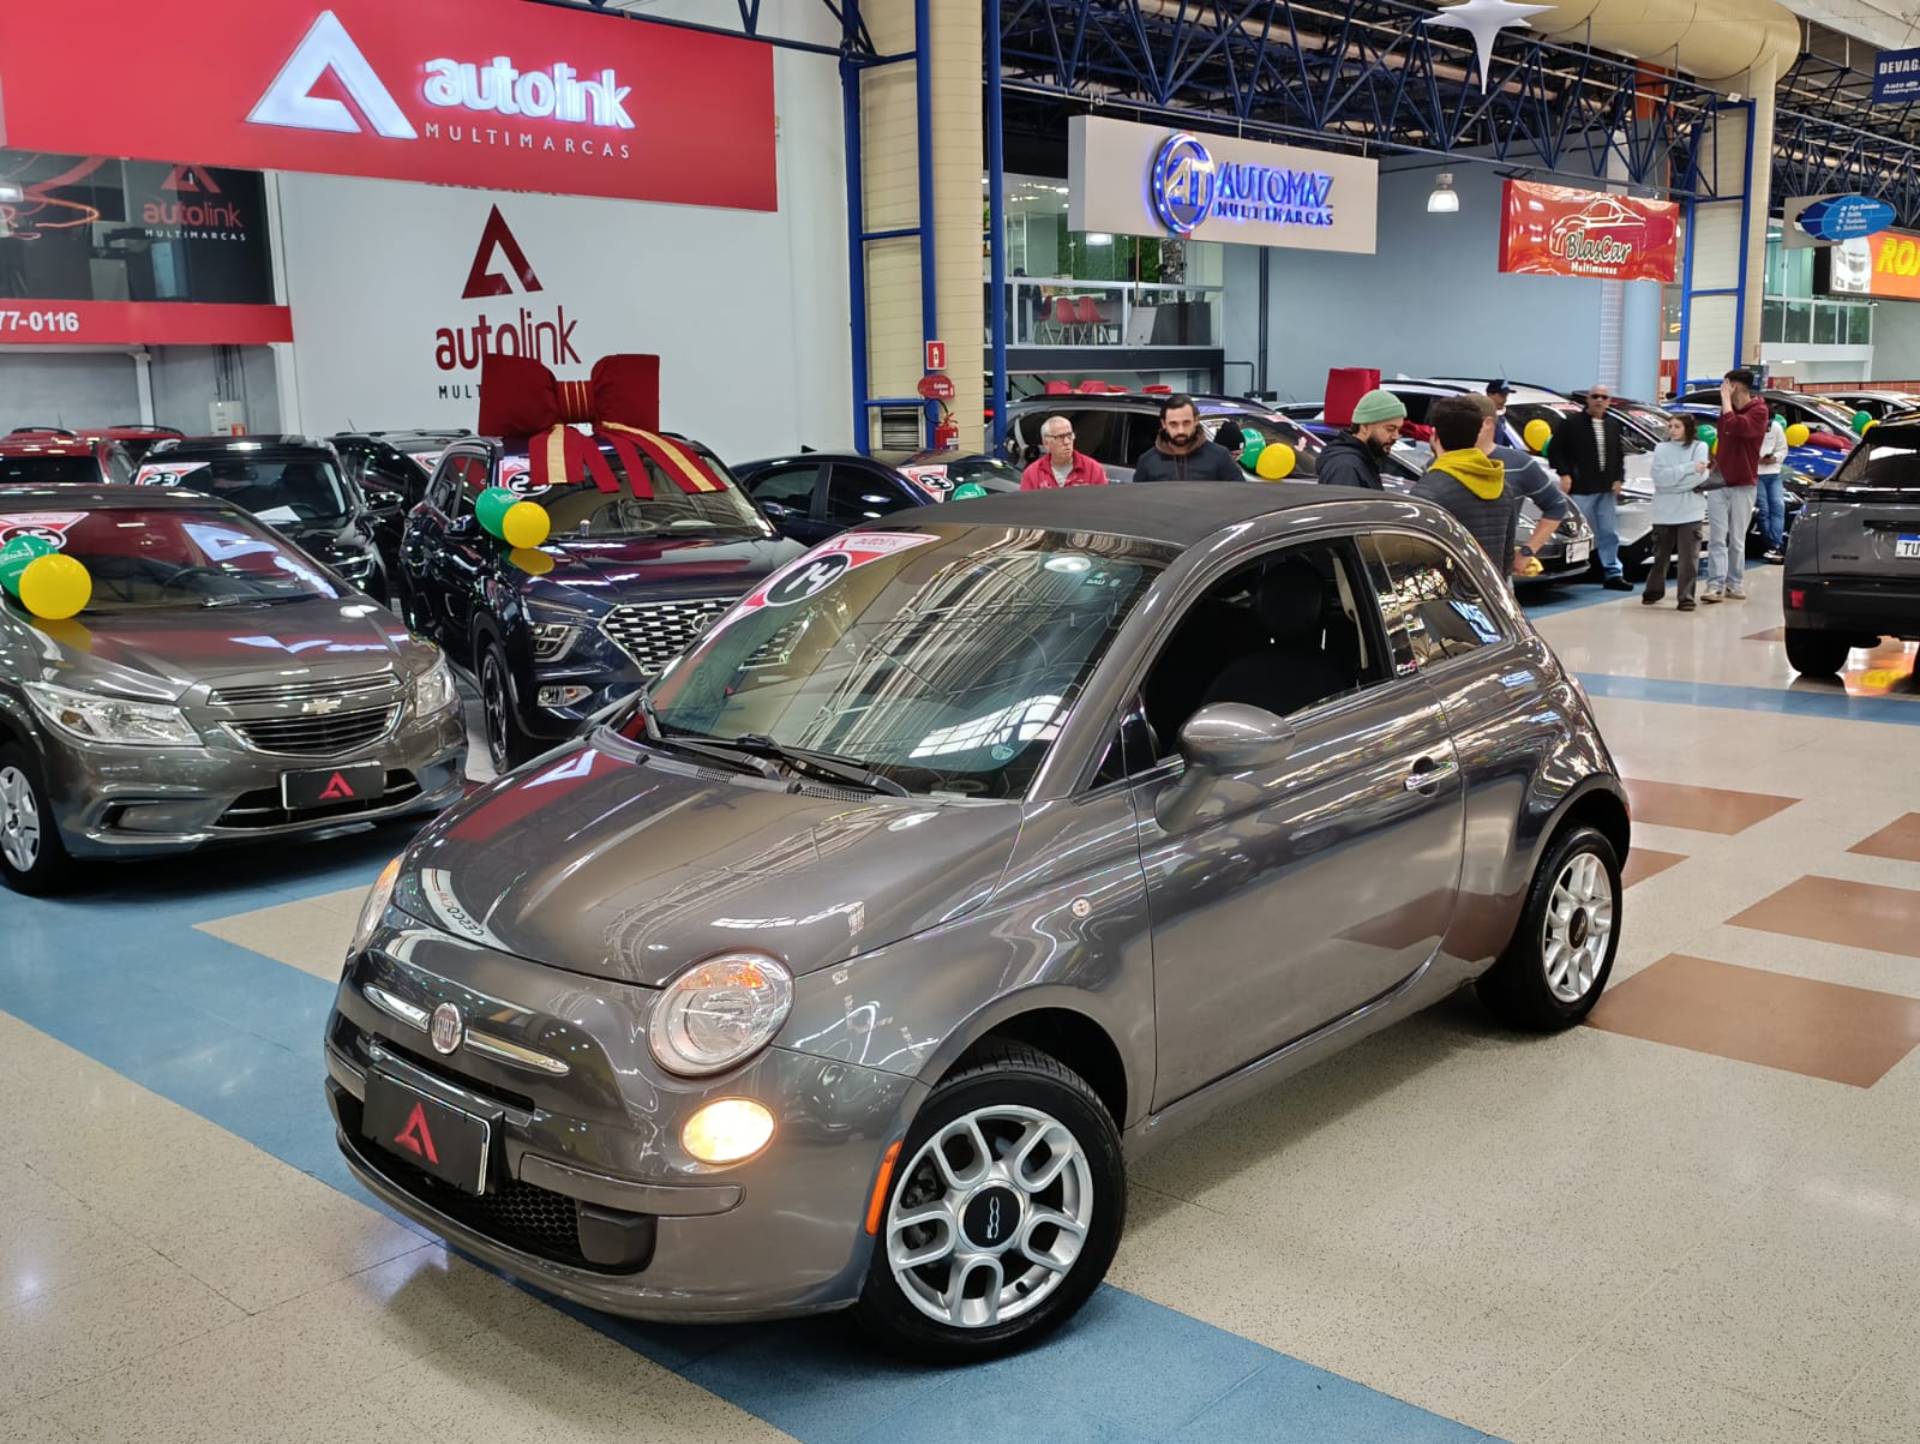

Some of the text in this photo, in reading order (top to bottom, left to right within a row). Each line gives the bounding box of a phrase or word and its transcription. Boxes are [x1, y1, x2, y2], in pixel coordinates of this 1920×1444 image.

[424, 56, 635, 128] autolink
[425, 122, 630, 159] MULTIMARCAS
[1217, 161, 1335, 208] AUTOMAZ
[143, 201, 244, 227] autolink
[1214, 200, 1334, 226] MULTIMARCAS
[144, 229, 246, 241] MULTIMARCAS
[1566, 229, 1632, 264] BlasCar
[1877, 237, 1920, 277] RO
[435, 304, 581, 371] autolink
